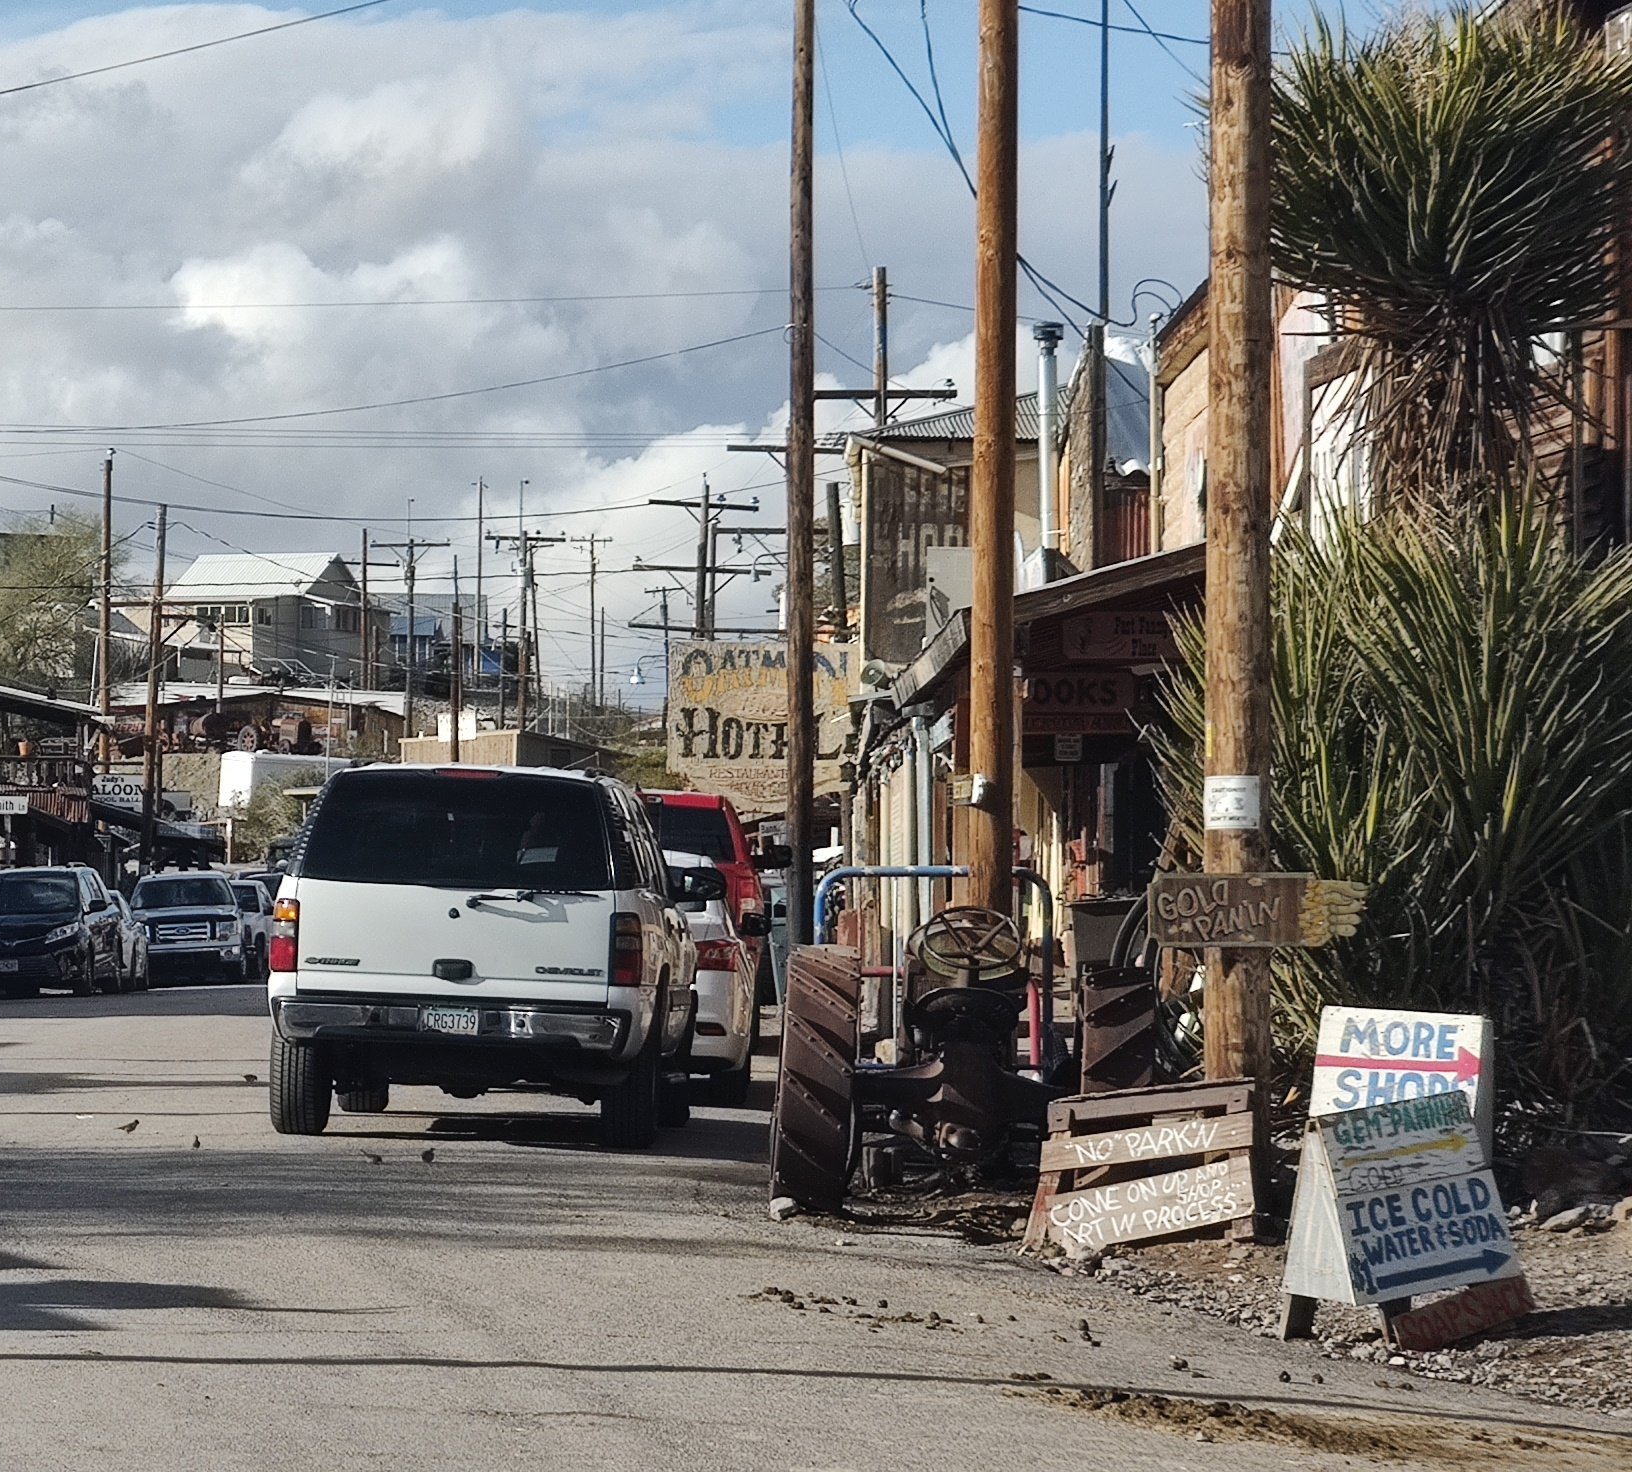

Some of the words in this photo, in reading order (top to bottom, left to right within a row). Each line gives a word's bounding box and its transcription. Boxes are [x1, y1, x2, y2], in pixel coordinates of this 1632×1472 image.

[681, 648, 849, 706] OATMN
[1031, 678, 1119, 706] OOKS
[92, 784, 144, 796] ALOON
[1156, 880, 1229, 921] GOLD
[426, 1012, 476, 1031] CRG3739
[1339, 1017, 1460, 1061] MORE
[1332, 1069, 1475, 1111] SHOP
[1333, 1111, 1383, 1146] GEM
[1050, 1187, 1120, 1228] COME
[1126, 1176, 1158, 1204] ON
[1162, 1171, 1189, 1196] UP
[1196, 1161, 1229, 1184] AND
[1345, 1193, 1407, 1237] ICE
[1410, 1177, 1491, 1223] COLD
[1063, 1216, 1106, 1246] ART
[1111, 1211, 1137, 1238] IN
[1142, 1191, 1238, 1232] PROCESS
[1360, 1225, 1436, 1267] WATER
[1447, 1213, 1507, 1248] SODA
